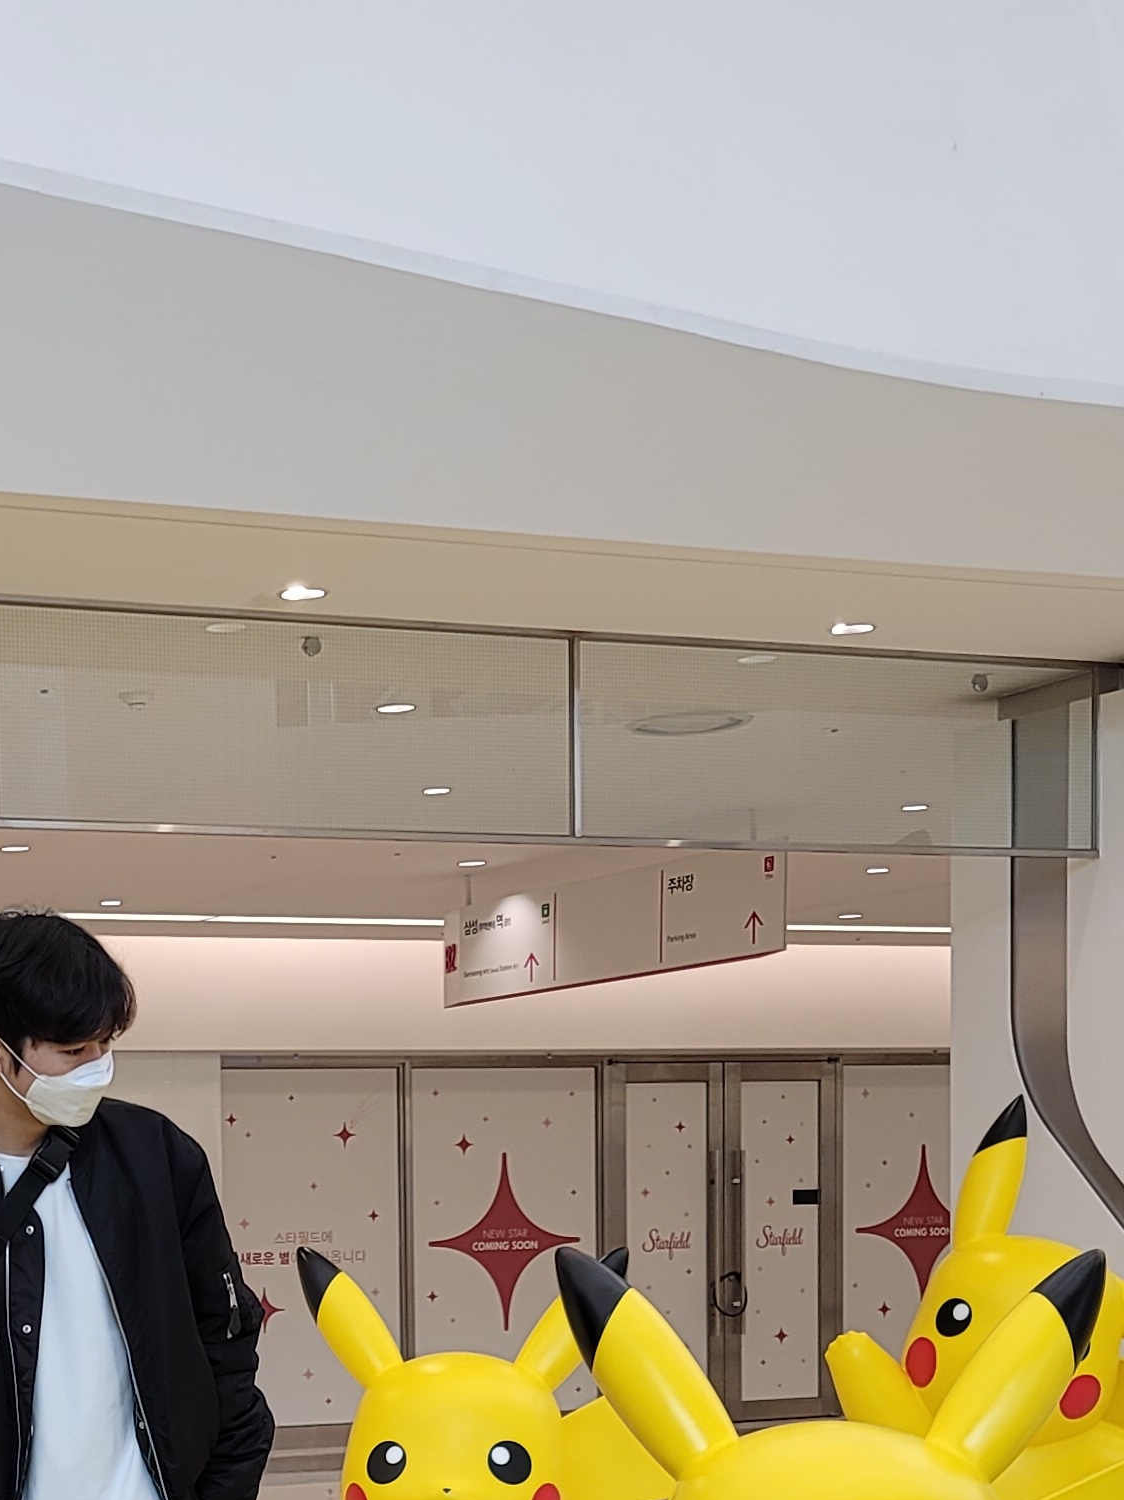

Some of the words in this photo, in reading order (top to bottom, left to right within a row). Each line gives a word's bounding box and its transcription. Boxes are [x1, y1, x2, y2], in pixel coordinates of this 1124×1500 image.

[667, 873, 695, 895] 주차장
[274, 1230, 333, 1245] 스타필드에
[482, 1229, 506, 1239] NEW
[508, 1228, 528, 1238] STAR
[894, 1227, 928, 1238] COMING
[472, 1241, 510, 1252] COMING
[511, 1240, 538, 1251] SOON
[642, 1228, 691, 1261] Starfield
[756, 1225, 804, 1257] Starfield
[240, 1251, 275, 1266] 새로운
